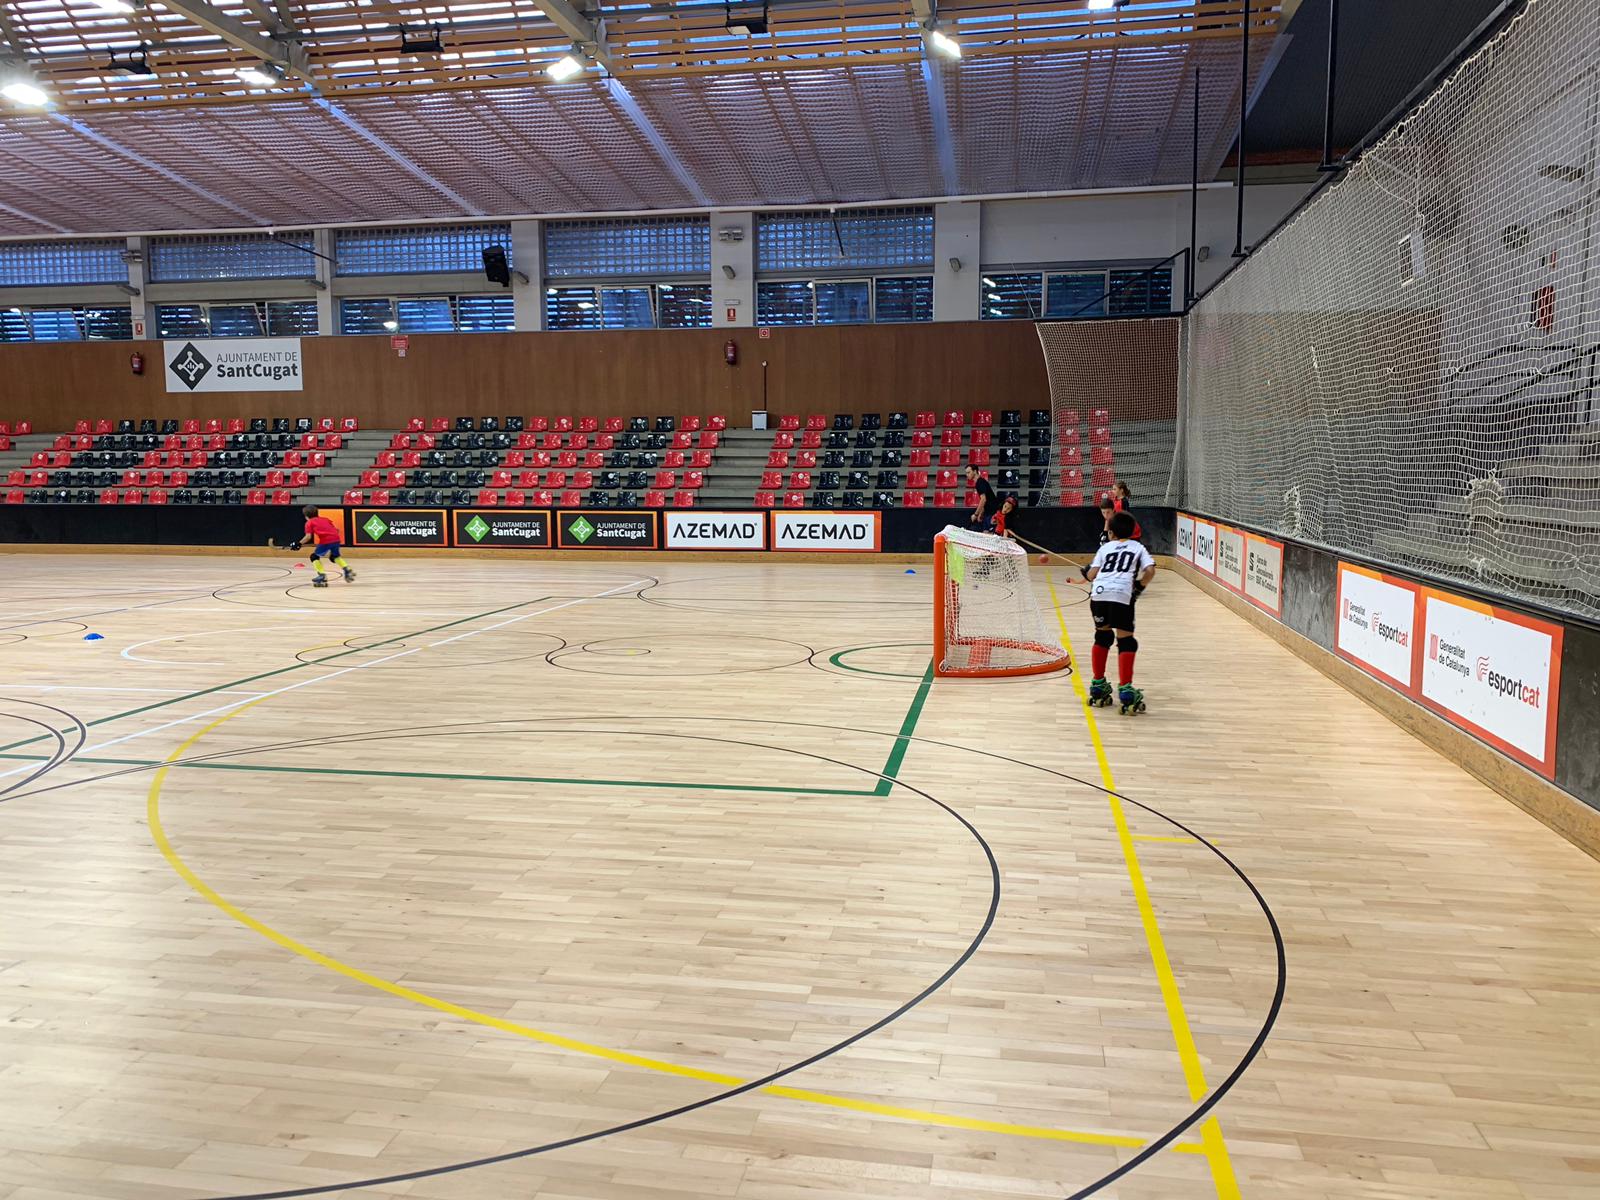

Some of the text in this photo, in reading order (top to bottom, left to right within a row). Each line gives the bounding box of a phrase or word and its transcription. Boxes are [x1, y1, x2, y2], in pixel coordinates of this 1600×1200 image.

[216, 351, 298, 363] AJUNTAMENT DE
[216, 363, 298, 380] SantCugat
[389, 526, 437, 537] SantCugat
[492, 527, 541, 538] SantCugat
[596, 528, 647, 540] SantCugat
[673, 523, 755, 539] AZEMAD
[781, 523, 866, 540] AZEMAD
[1101, 551, 1135, 573] 80
[1378, 622, 1409, 647] esportcat
[1439, 638, 1466, 660] Generalitat
[1438, 653, 1470, 678] de Catalunya
[1488, 670, 1541, 709] esportcat
